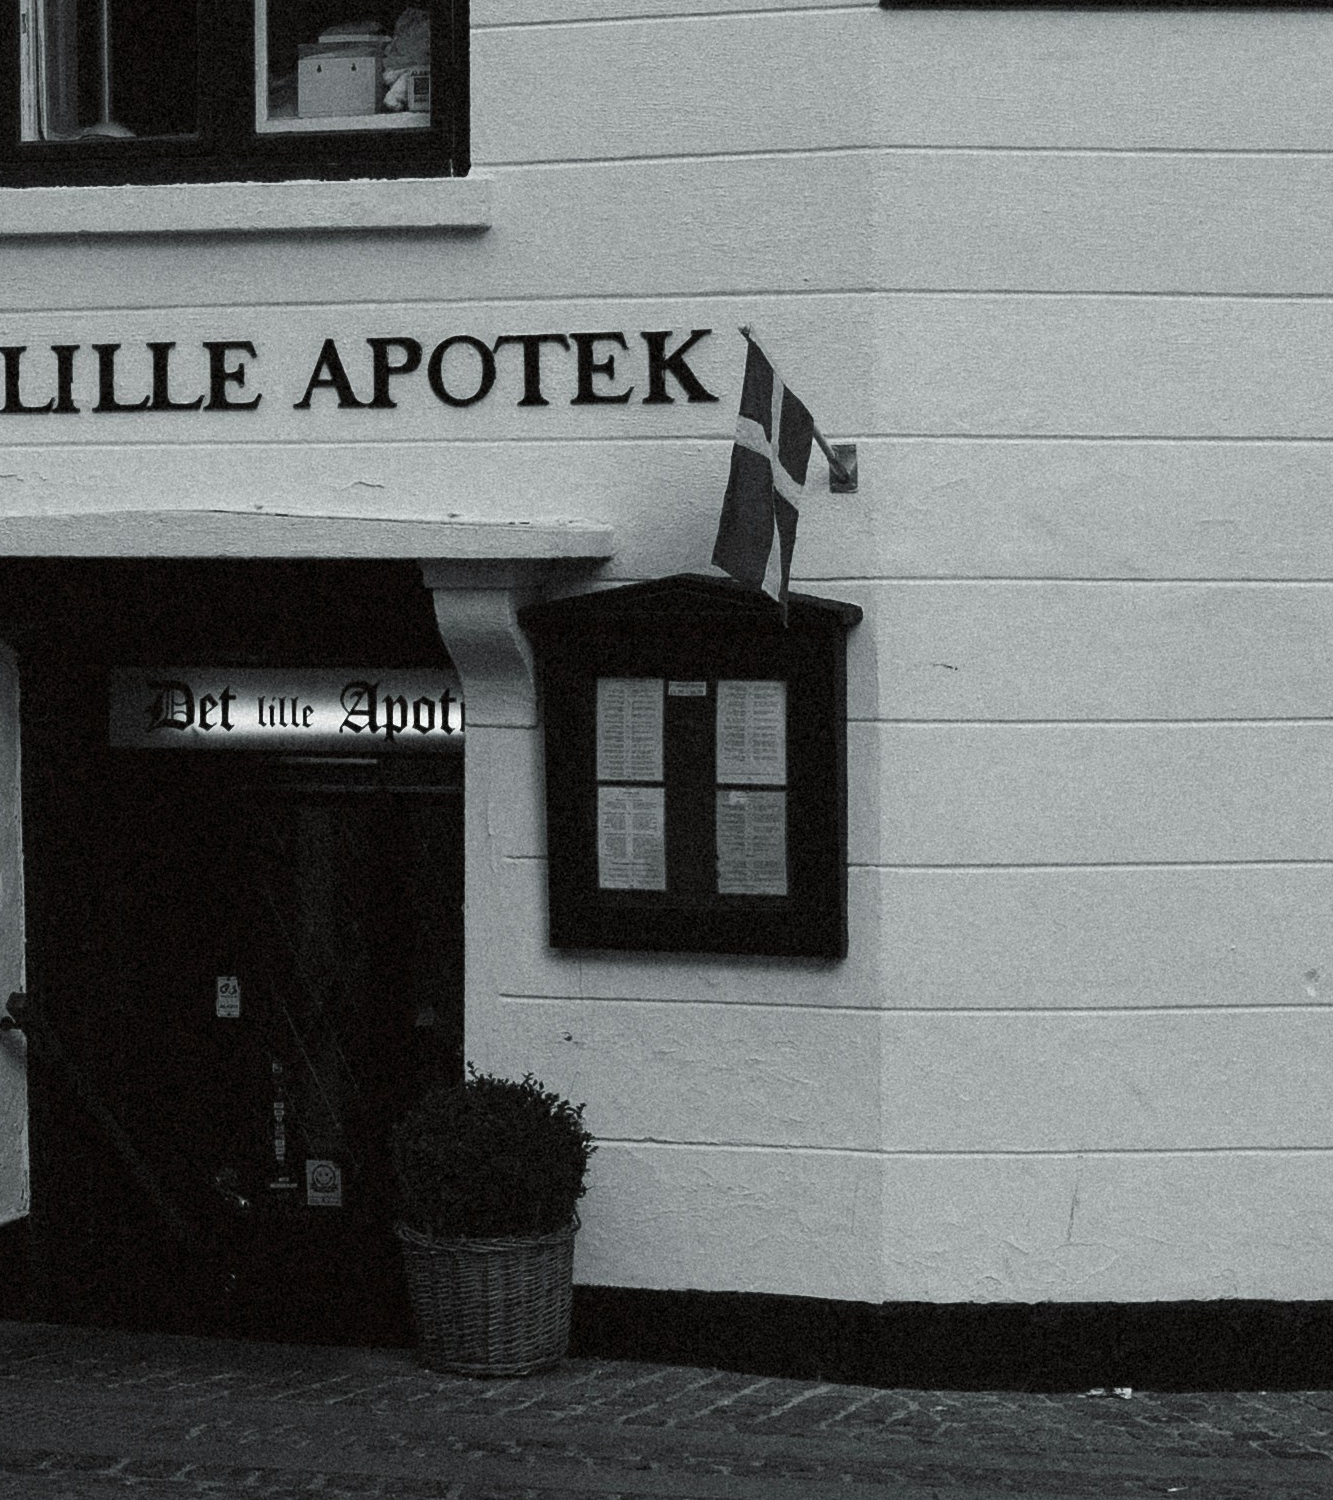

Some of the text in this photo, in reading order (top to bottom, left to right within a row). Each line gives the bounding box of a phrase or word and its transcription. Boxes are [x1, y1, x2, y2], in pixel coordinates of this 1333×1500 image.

[292, 328, 719, 411] APOTEK
[146, 678, 465, 744] Det lille Apot
